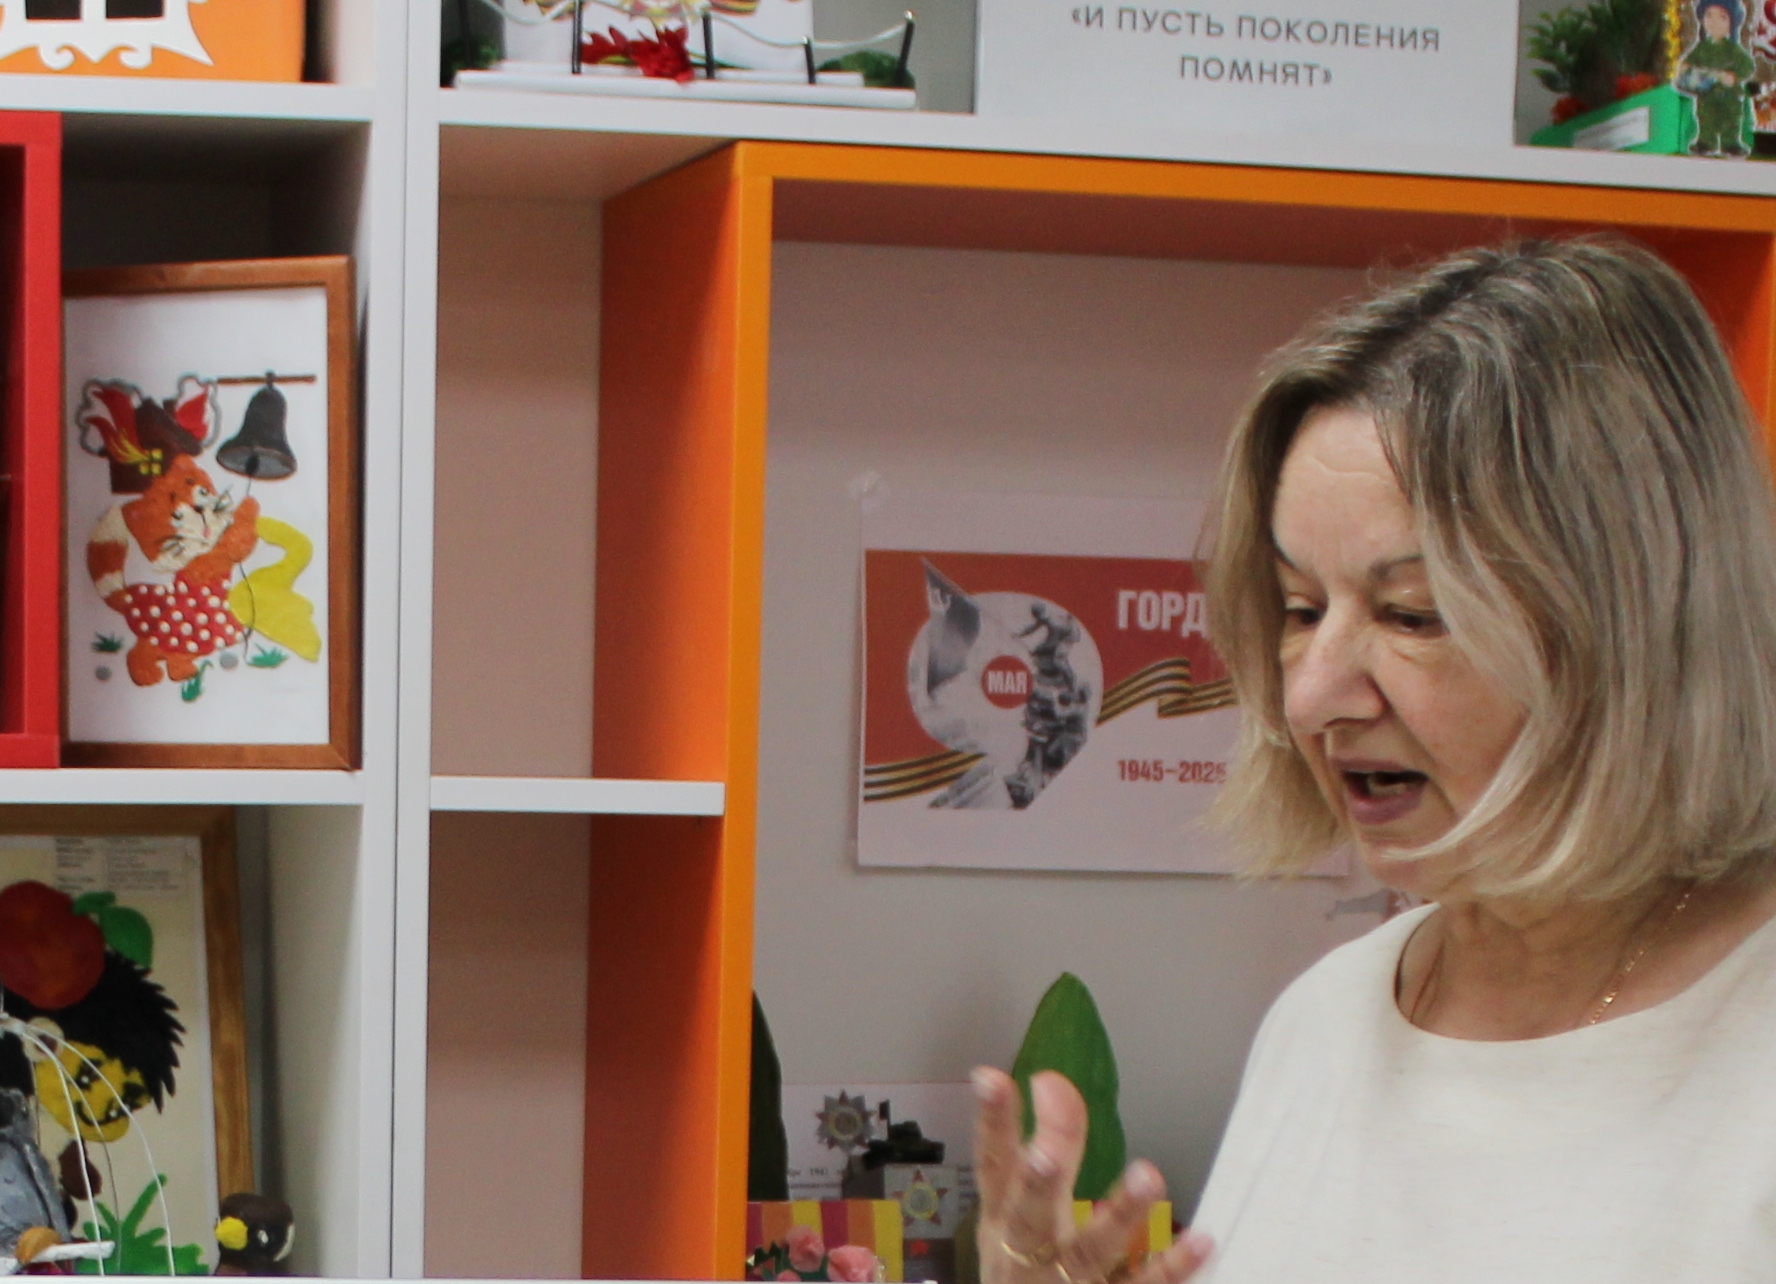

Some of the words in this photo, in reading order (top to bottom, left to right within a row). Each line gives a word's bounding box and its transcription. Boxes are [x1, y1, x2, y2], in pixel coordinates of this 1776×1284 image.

[1071, 7, 1105, 29] «И
[1116, 8, 1225, 38] ПУСТЬ
[1237, 14, 1441, 52] ПОКОЛЕНИЯ
[1179, 55, 1333, 86] ПОМНЯТ»
[1118, 590, 1209, 639] ГОРД
[987, 669, 1028, 694] МАЯ
